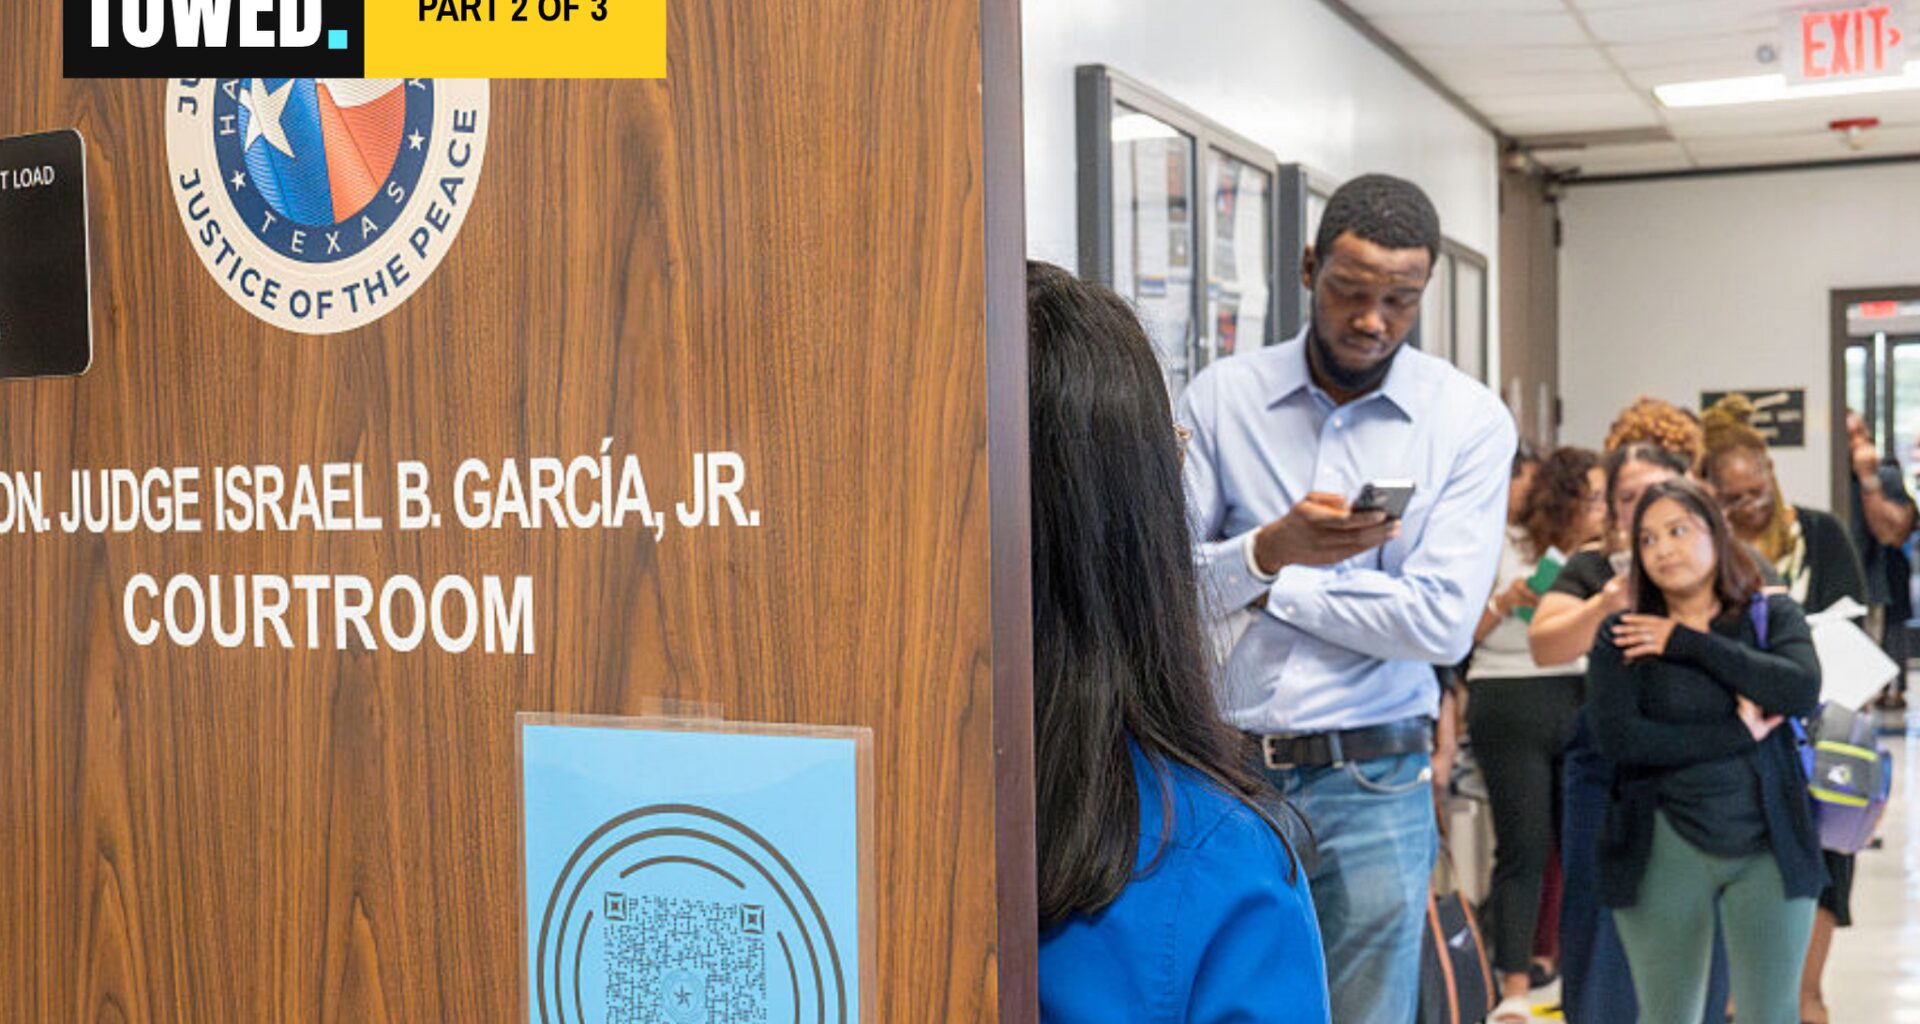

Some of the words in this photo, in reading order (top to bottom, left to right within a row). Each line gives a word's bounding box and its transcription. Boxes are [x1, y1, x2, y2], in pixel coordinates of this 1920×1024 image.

[1801, 6, 1891, 78] EXIT
[13, 165, 55, 189] LOAD
[179, 167, 282, 310] JUSTICE
[289, 289, 334, 320] OF
[341, 254, 411, 313] THE
[408, 109, 477, 260] PEACE
[260, 180, 406, 254] TEXAS
[60, 467, 201, 533] JUDGE
[214, 462, 382, 532] ISRAEL
[397, 460, 441, 530] B.
[453, 437, 665, 542] GARCÍA,
[676, 451, 761, 528] JR.
[123, 573, 536, 655] COURTROOM
